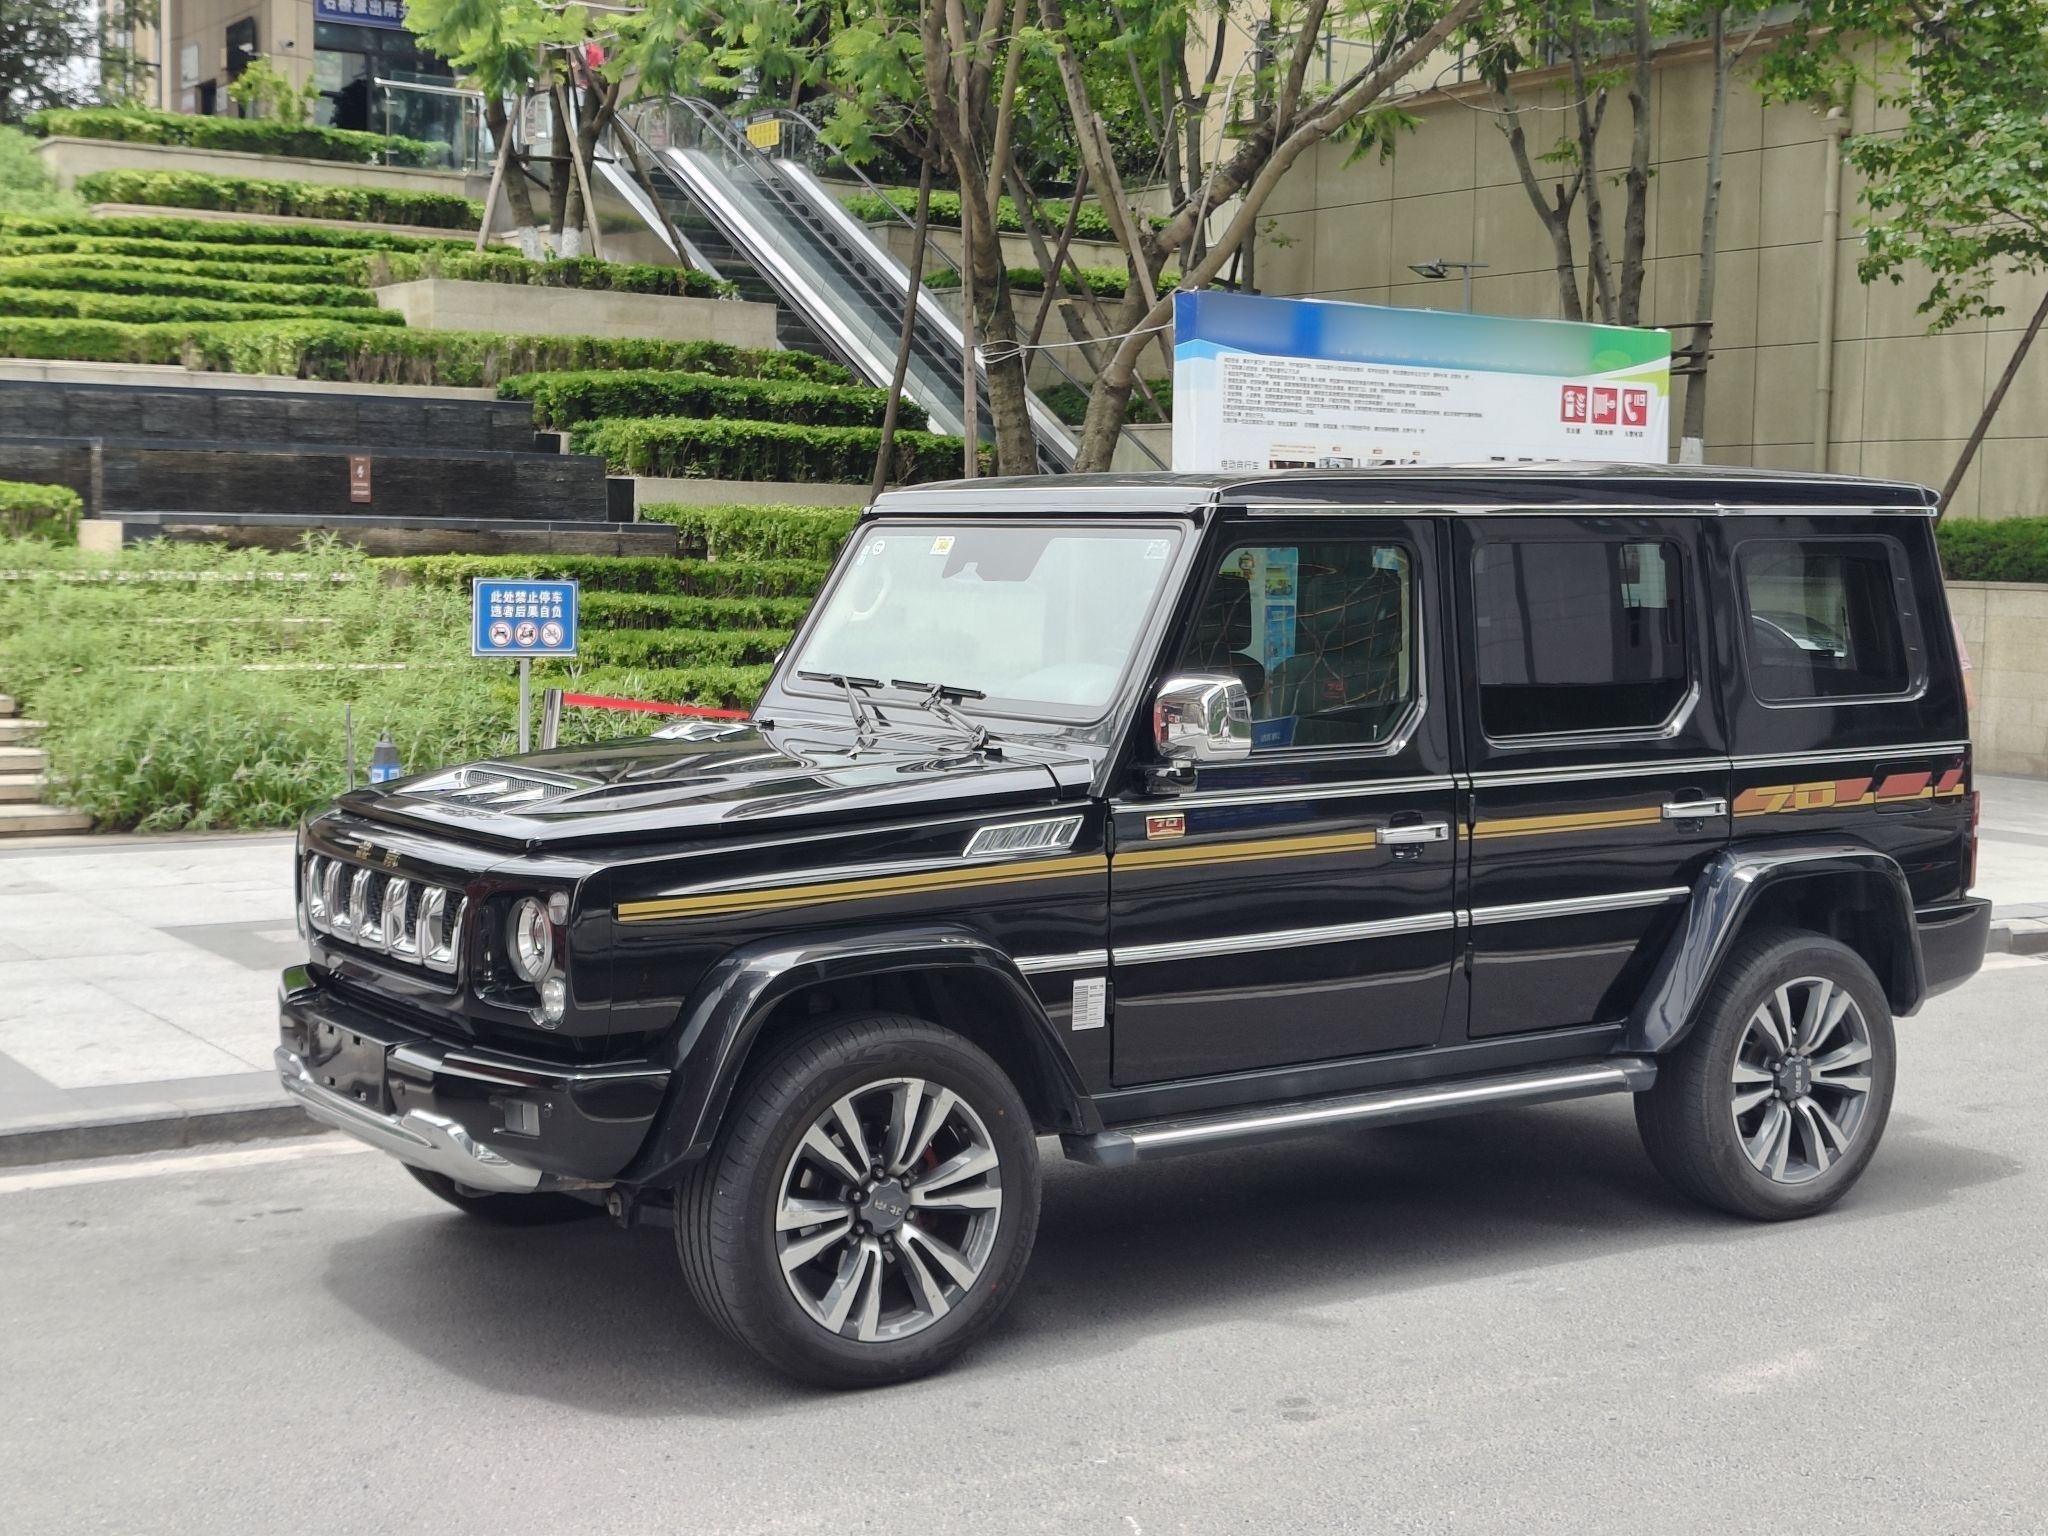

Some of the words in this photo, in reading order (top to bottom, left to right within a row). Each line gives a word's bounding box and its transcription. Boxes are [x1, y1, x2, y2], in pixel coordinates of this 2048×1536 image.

[490, 590, 563, 604] 此处禁止停车
[490, 605, 562, 618] 违者后果自负
[1755, 781, 1836, 814] 70
